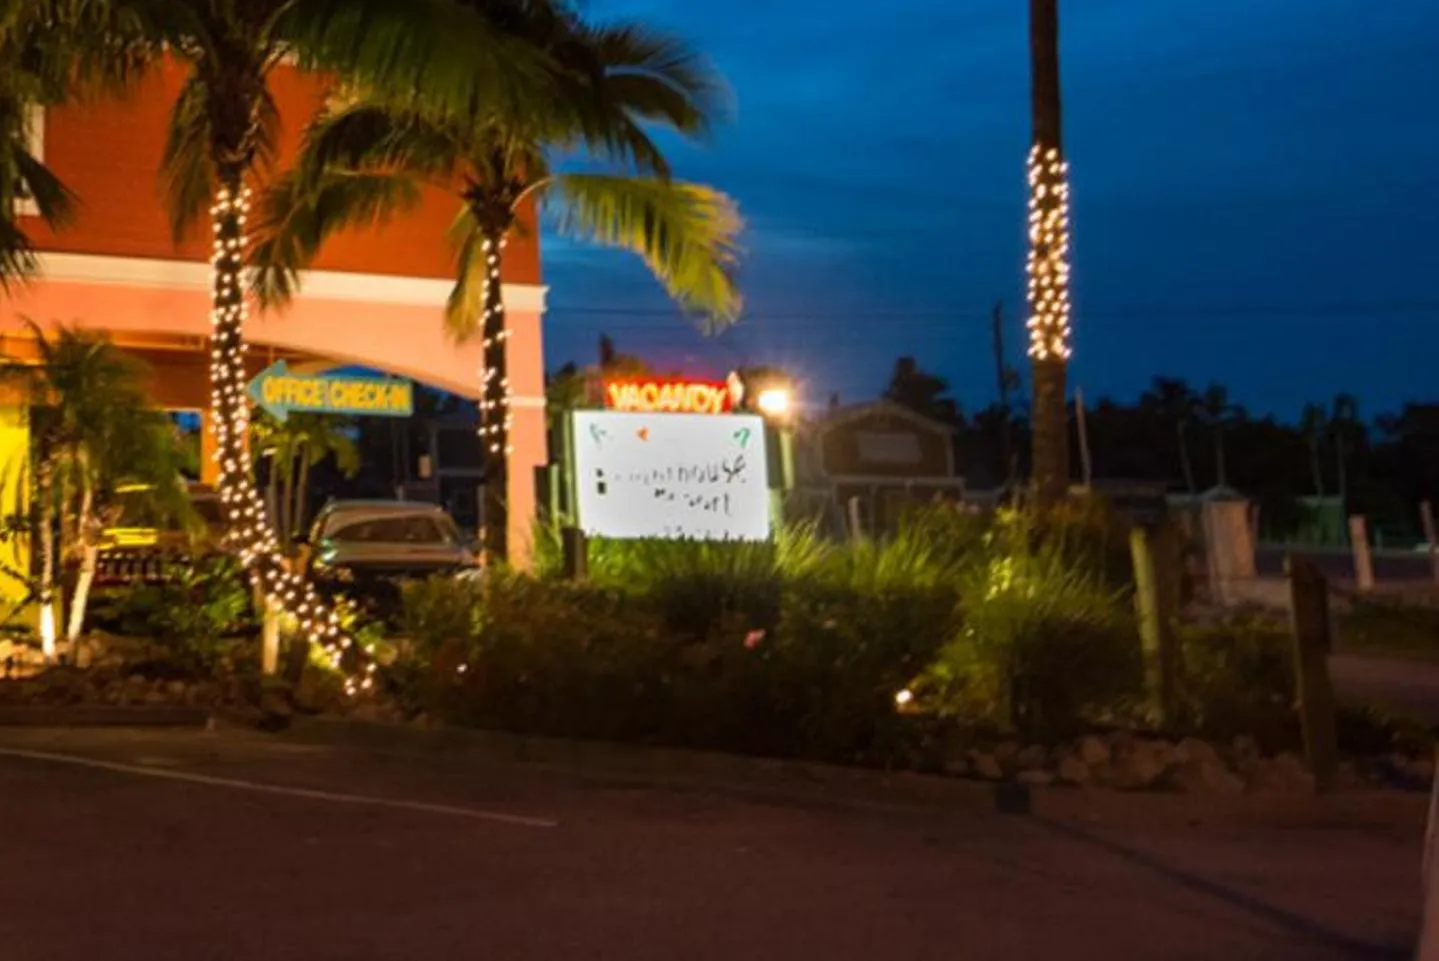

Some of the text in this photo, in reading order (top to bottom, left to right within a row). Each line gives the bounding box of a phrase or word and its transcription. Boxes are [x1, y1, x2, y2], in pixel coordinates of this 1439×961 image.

[263, 375, 410, 412] OFFICE CHECK-IN
[608, 382, 727, 415] VACANCY
